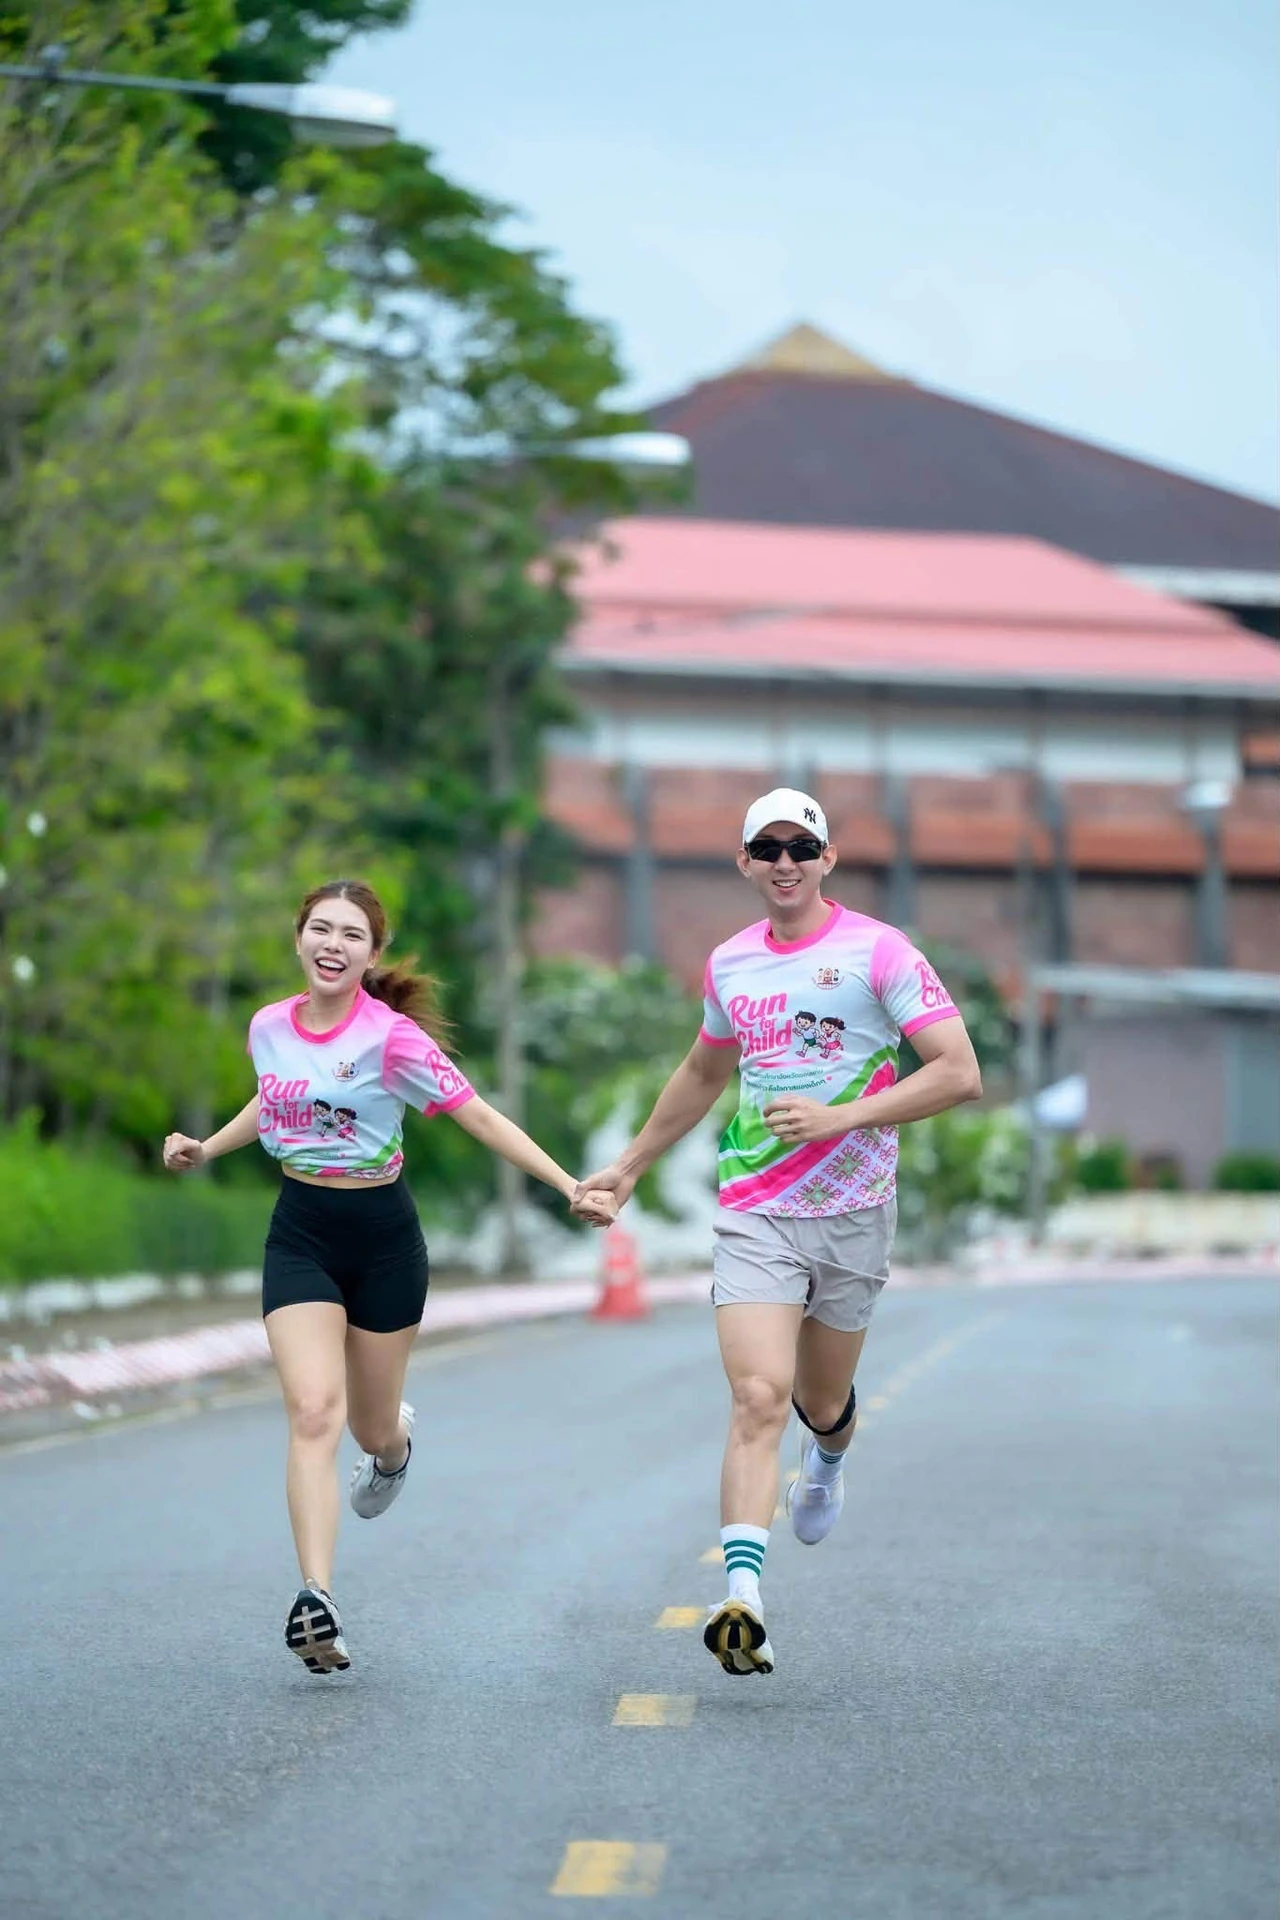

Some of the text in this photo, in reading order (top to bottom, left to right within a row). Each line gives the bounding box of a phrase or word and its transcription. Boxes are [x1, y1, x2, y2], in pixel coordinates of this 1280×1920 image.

[728, 993, 788, 1028] Run
[759, 1017, 778, 1031] for
[737, 1019, 793, 1058] Child
[259, 1073, 310, 1106] Run
[284, 1099, 300, 1111] for
[257, 1103, 313, 1134] Child
